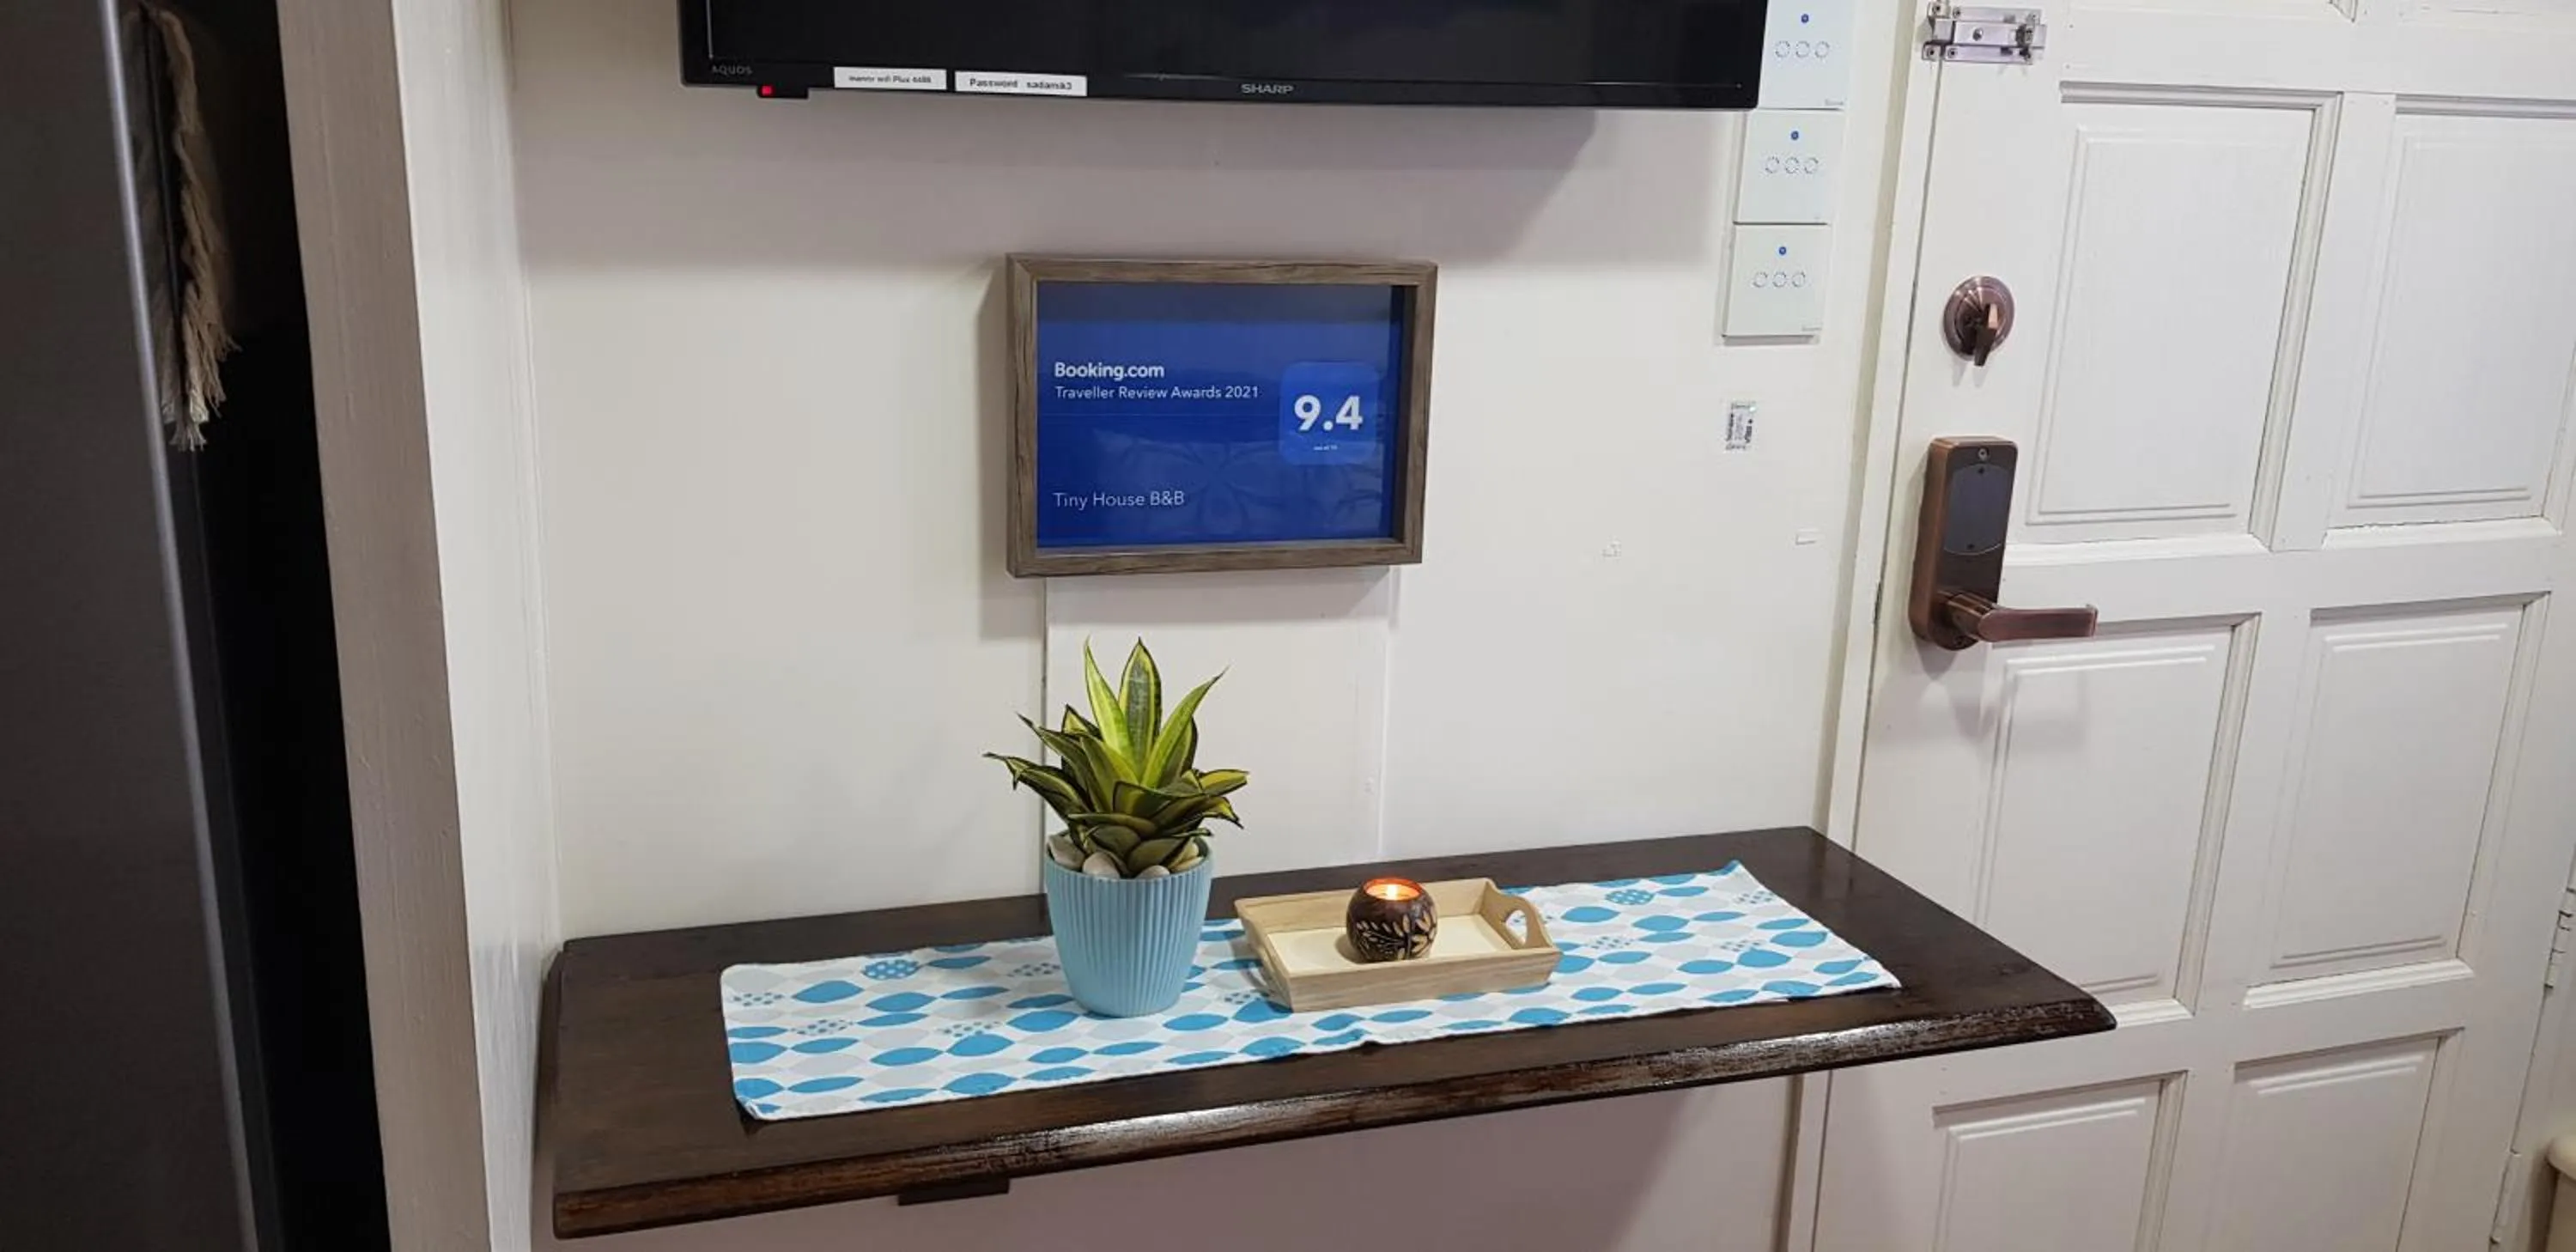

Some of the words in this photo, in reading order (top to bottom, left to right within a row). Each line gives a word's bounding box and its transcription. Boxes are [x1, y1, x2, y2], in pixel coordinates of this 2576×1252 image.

[713, 64, 753, 76] AQUOS
[969, 78, 1018, 88] Password
[1241, 83, 1294, 94] SHARP
[1054, 362, 1165, 382] Booking.com
[1054, 386, 1115, 399] Traveller
[1119, 386, 1168, 399] Review
[1170, 385, 1222, 399] Awards
[1225, 385, 1259, 399] 2021
[1294, 395, 1364, 431] 9.4
[1053, 492, 1088, 511] Tiny
[1092, 491, 1145, 507] House
[1150, 490, 1185, 506] B&B
